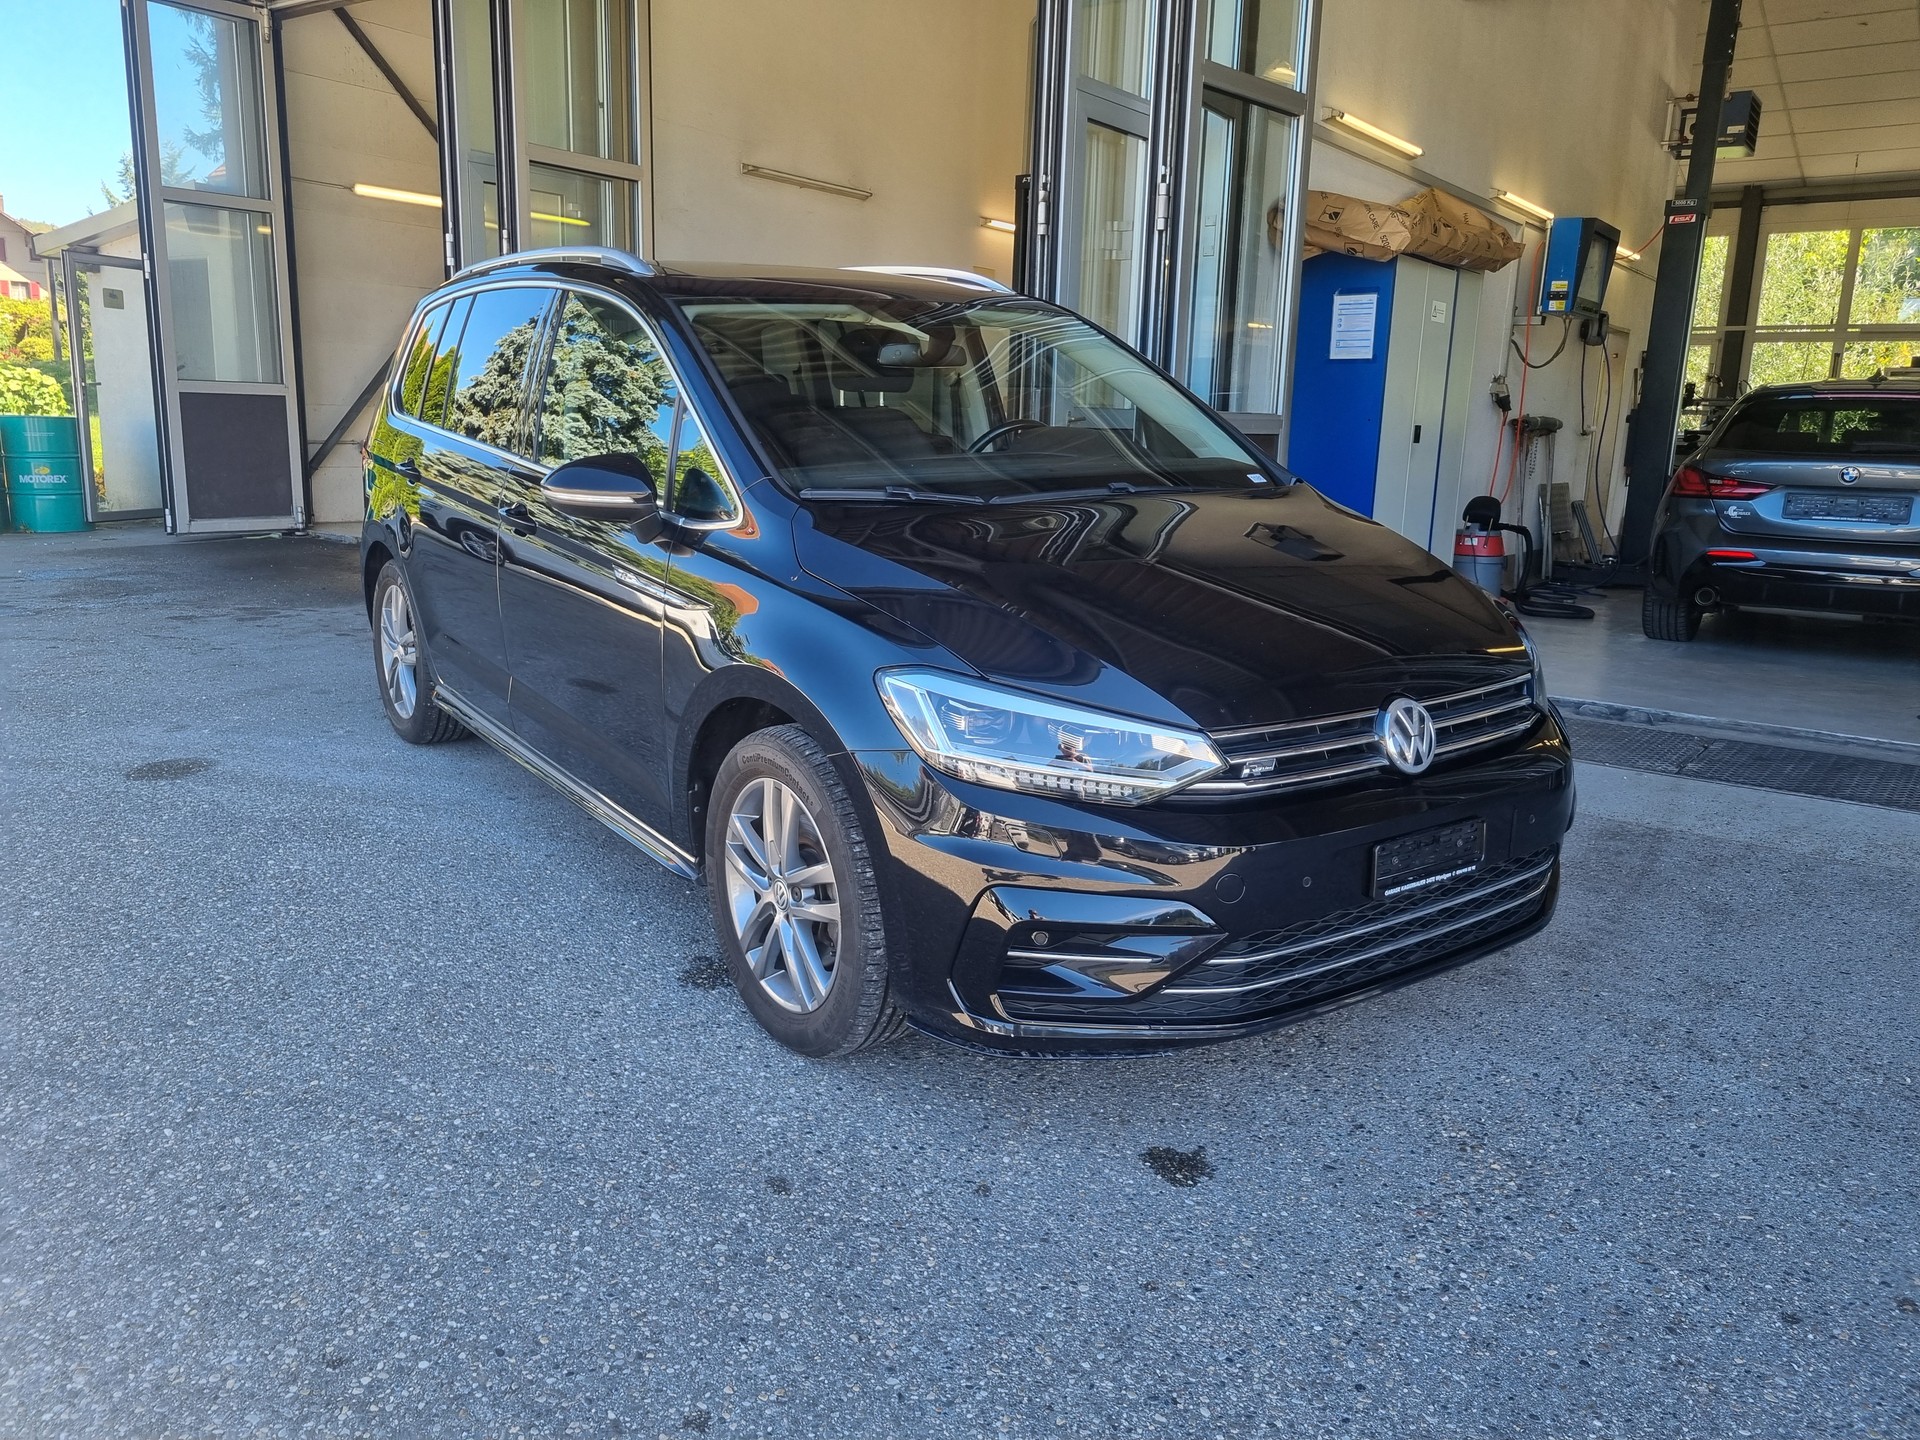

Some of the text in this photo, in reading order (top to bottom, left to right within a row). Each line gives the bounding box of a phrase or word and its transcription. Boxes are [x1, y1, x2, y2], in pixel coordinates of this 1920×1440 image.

[1369, 213, 1380, 230] CARE
[19, 475, 68, 483] MOTOREX
[742, 753, 810, 803] ContiPremiumContact
